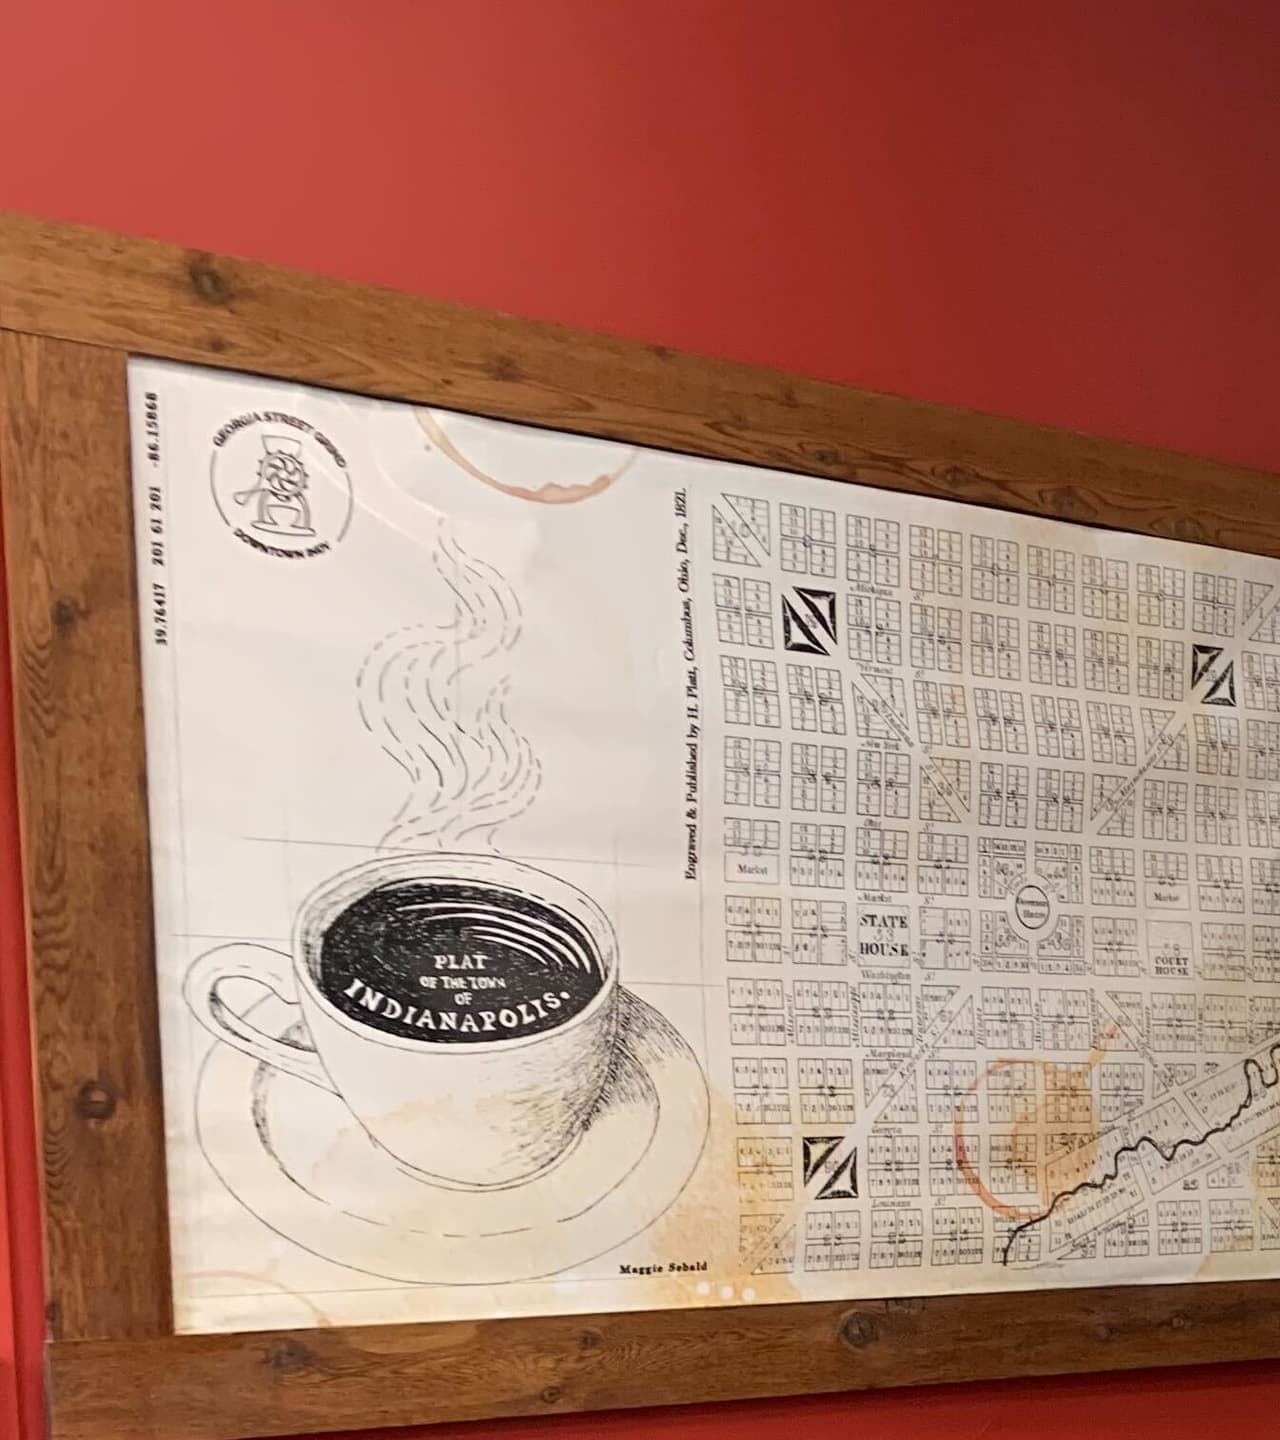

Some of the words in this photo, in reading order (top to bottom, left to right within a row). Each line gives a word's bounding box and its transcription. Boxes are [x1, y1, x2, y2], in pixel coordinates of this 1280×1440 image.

[686, 724, 700, 739] by
[685, 744, 697, 802] Published
[685, 824, 698, 880] Engraved
[737, 863, 768, 876] Market
[1153, 891, 1180, 902] Market
[860, 914, 908, 929] STATE
[860, 942, 910, 957] HOUSE
[433, 954, 489, 969] PLAT
[1155, 956, 1189, 966] COURT
[1155, 966, 1189, 976] HOUSE
[419, 976, 437, 989] OF
[441, 976, 469, 990] THE
[470, 976, 506, 990] TOWN
[454, 992, 472, 1005] OF
[619, 1264, 663, 1275] Maggie
[668, 1260, 708, 1272] Sebald
